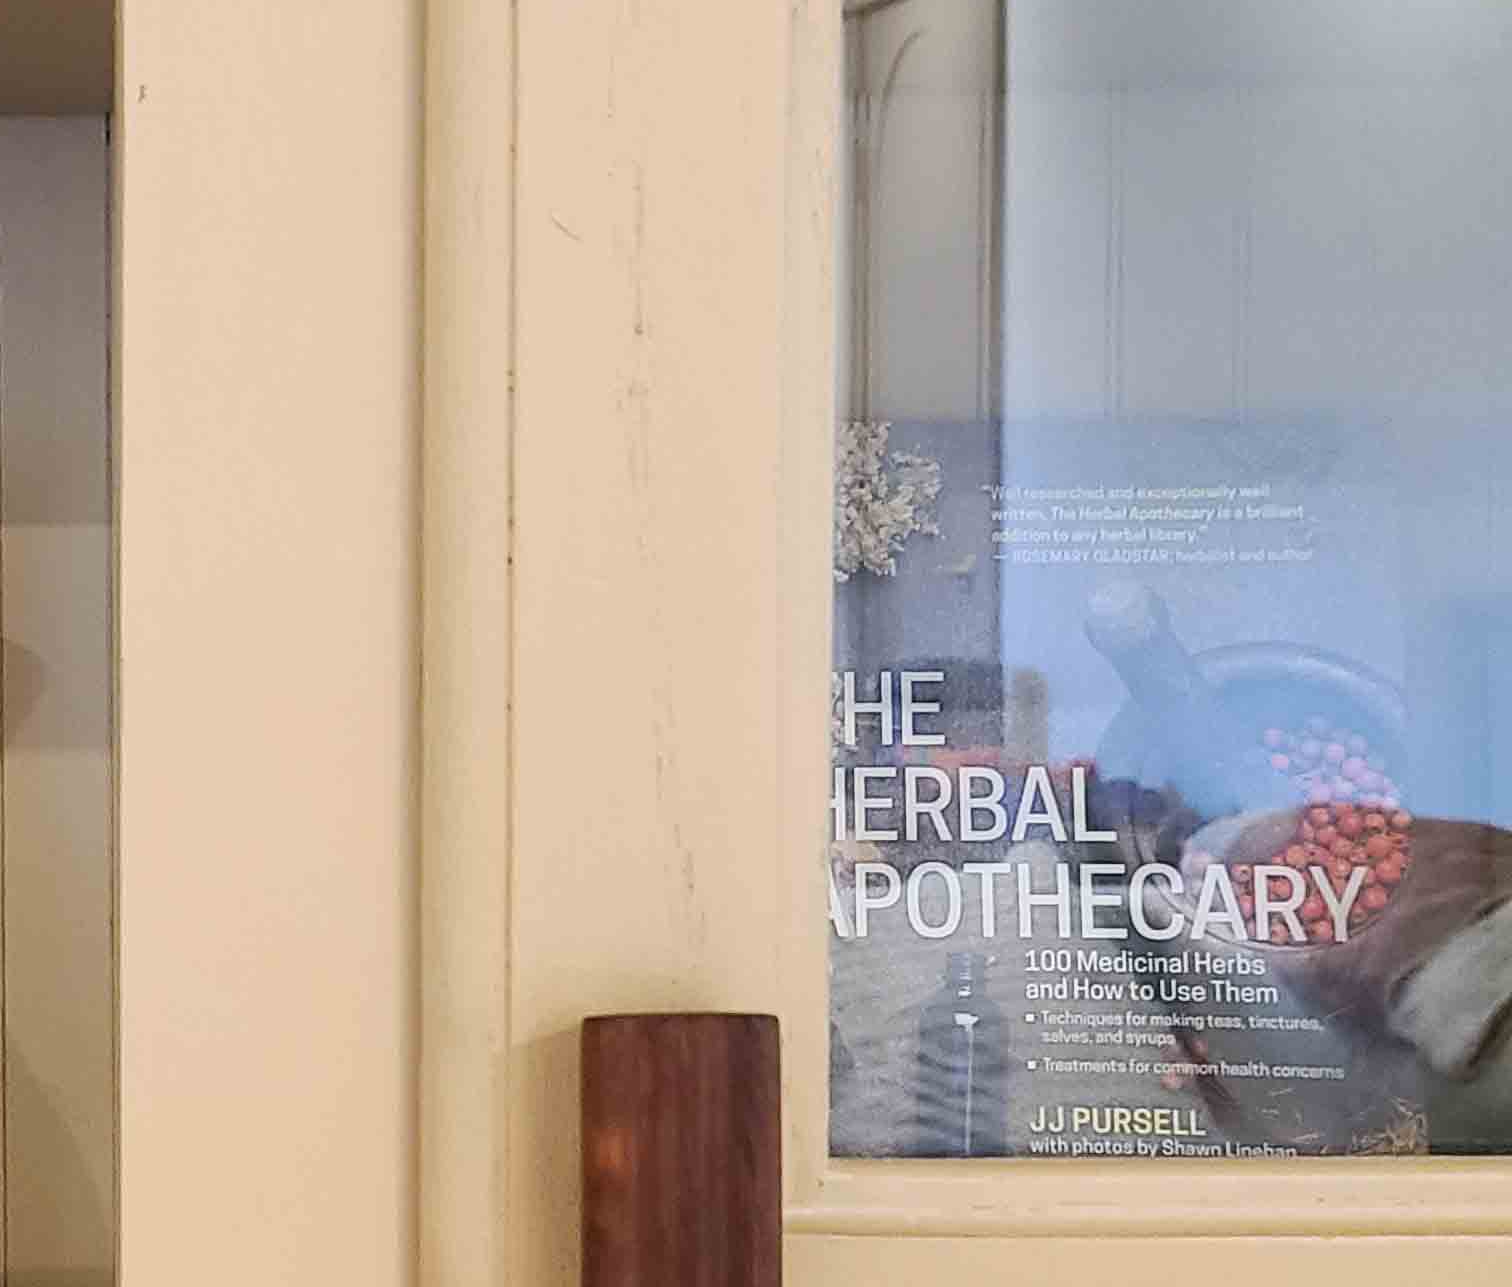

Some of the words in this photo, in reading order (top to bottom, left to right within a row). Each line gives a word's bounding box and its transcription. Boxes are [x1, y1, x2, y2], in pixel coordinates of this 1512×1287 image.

[832, 671, 946, 746] HE
[1024, 950, 1071, 972] 100
[1078, 950, 1187, 974] Medicinal
[1194, 951, 1266, 975] Herbs
[1025, 978, 1067, 1000] and
[1073, 979, 1124, 1000] How
[1128, 981, 1154, 1001] to
[1159, 979, 1206, 1002] Use
[1211, 980, 1279, 1004] Them
[1042, 1011, 1122, 1030] Techniques
[1125, 1012, 1148, 1027] for
[1150, 1013, 1205, 1031] making
[1208, 1014, 1246, 1031] teas,
[1040, 1029, 1093, 1045] salves,
[1096, 1030, 1123, 1044] and
[1125, 1031, 1176, 1047] syrups
[1044, 1057, 1125, 1073] Treatments
[1129, 1059, 1151, 1073] for
[1151, 1062, 1219, 1077] common
[1221, 1062, 1270, 1078] health
[1272, 1064, 1345, 1080] concerns
[1030, 1108, 1064, 1133] JJ
[1073, 1108, 1207, 1136] PURSELL
[1030, 1136, 1067, 1154] with
[1071, 1136, 1132, 1157] photos
[1137, 1138, 1159, 1158] by
[1161, 1138, 1222, 1158] Shawn
